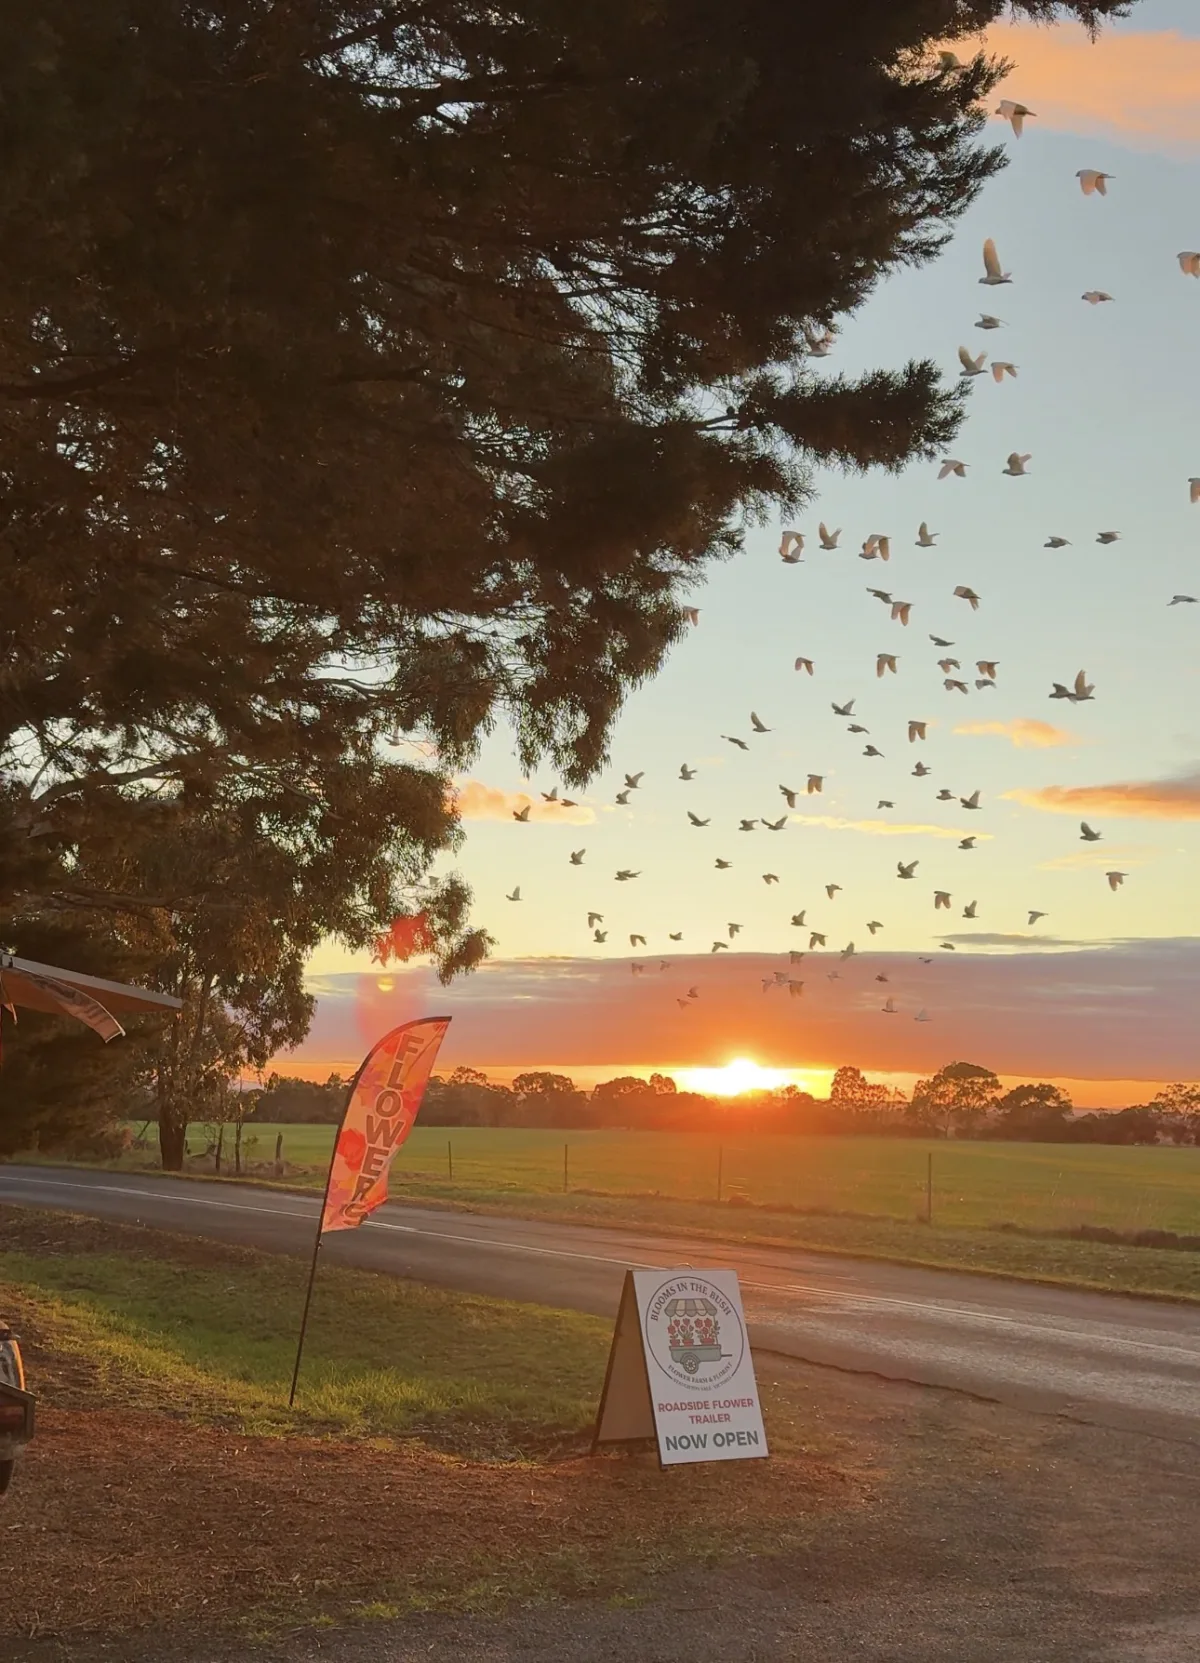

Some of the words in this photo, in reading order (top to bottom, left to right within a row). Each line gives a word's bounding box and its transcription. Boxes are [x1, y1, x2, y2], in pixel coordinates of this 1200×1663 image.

[650, 1285, 676, 1322] BLOOMS
[676, 1282, 688, 1292] IN
[690, 1282, 708, 1295] THE
[709, 1290, 732, 1316] BUSH
[667, 1364, 691, 1382] FLOWER
[691, 1376, 708, 1384] FARM
[713, 1361, 733, 1381] FLORIST
[658, 1400, 710, 1413] ROADSIDE
[712, 1398, 754, 1409] FLOWER
[688, 1413, 731, 1425] TRAILER
[665, 1433, 708, 1451] NOW
[712, 1430, 759, 1448] OPEN
